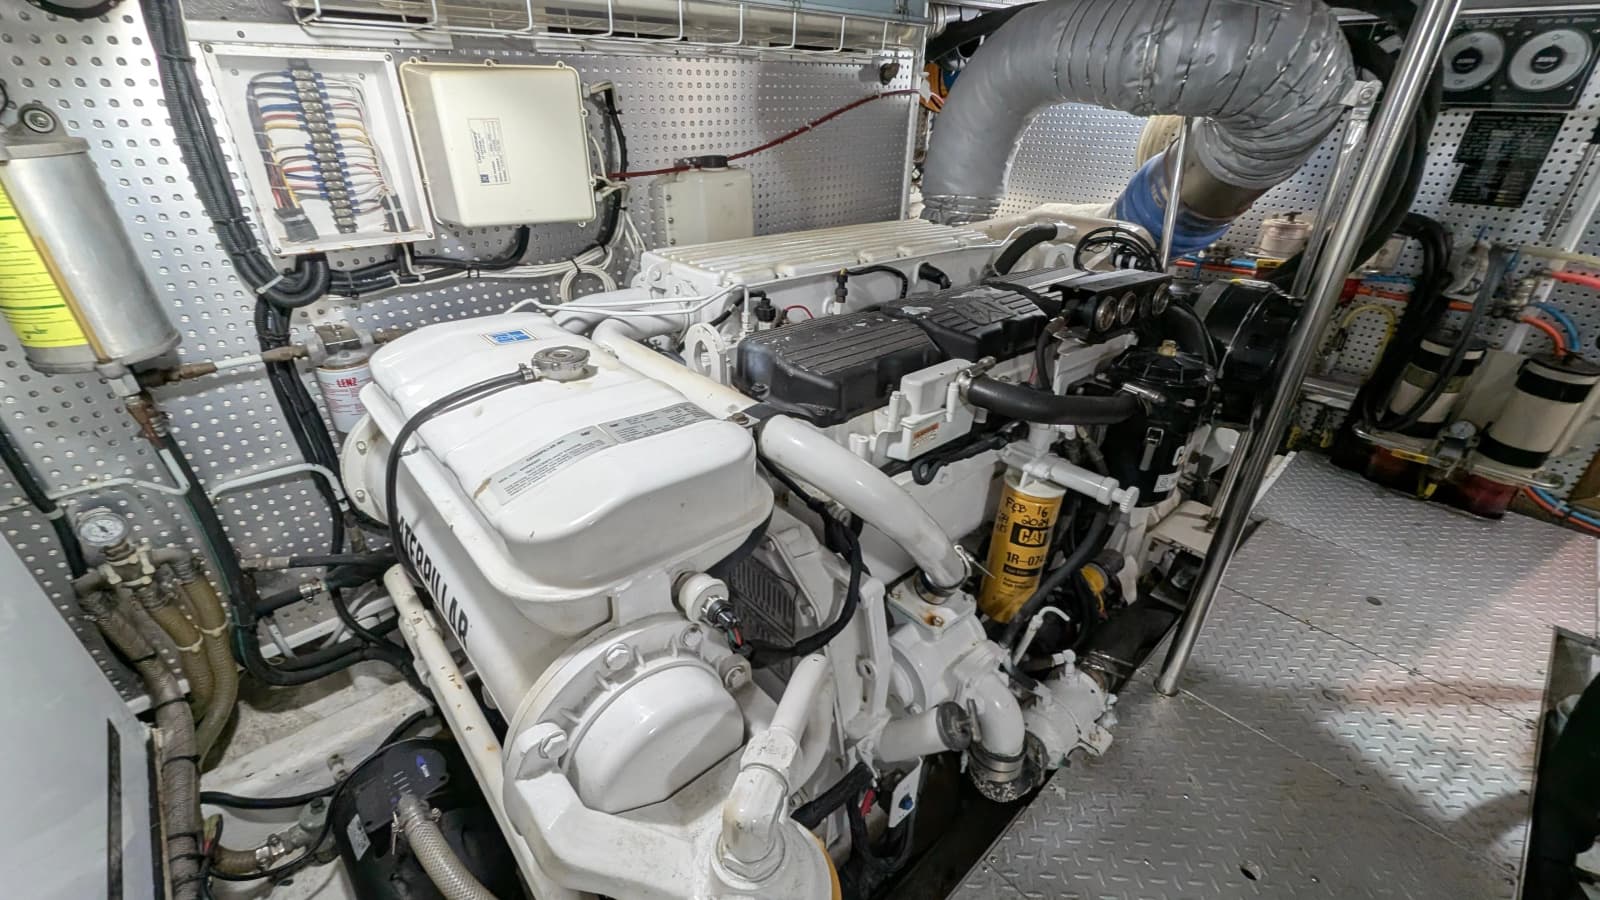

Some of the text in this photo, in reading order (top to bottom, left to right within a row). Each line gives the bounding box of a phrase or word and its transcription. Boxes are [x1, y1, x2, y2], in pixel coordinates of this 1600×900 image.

[336, 377, 358, 388] LENZ
[1005, 496, 1049, 518] FEB 16
[1018, 528, 1046, 545] CAT
[399, 515, 469, 653] ATERPILLAR
